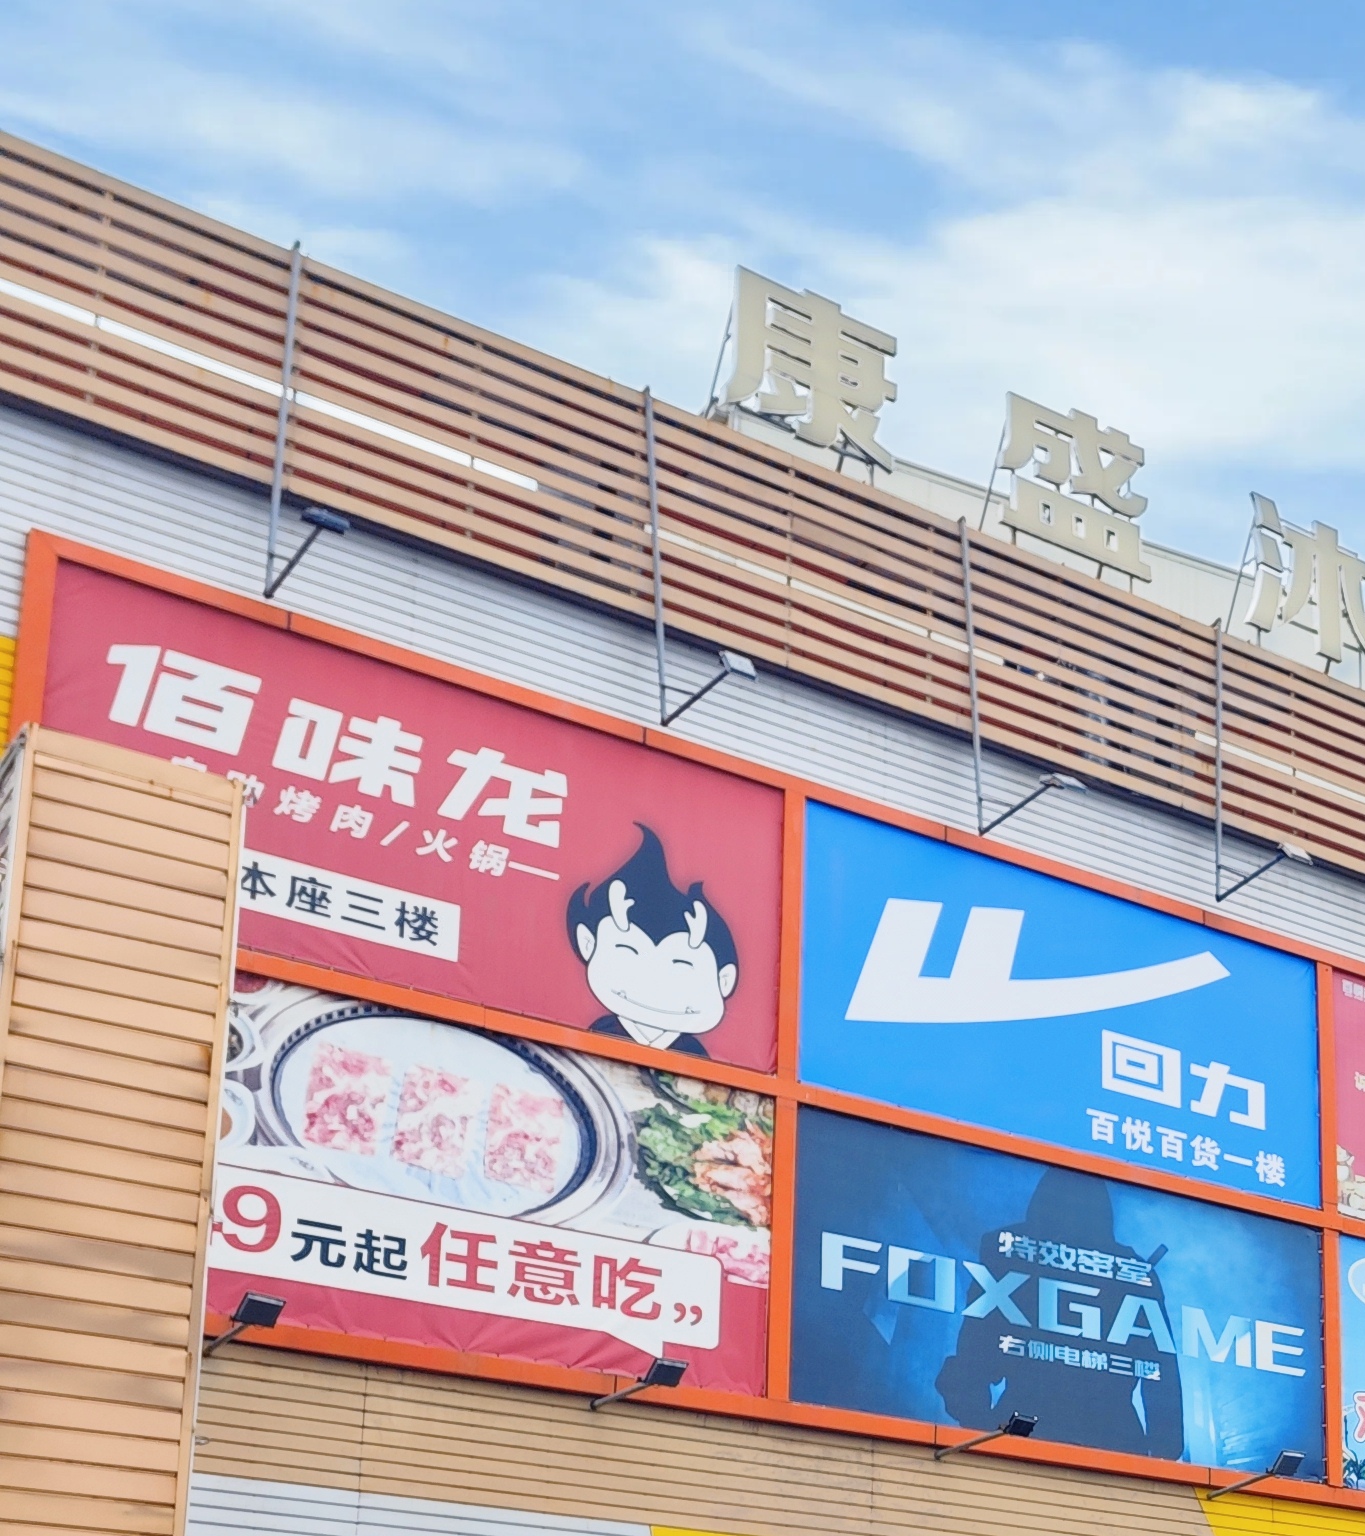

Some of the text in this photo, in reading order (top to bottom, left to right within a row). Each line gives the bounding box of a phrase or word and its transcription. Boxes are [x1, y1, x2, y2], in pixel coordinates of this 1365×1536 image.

[106, 643, 569, 848] 佰味龙
[241, 862, 440, 946] 本座三楼
[1101, 1028, 1267, 1131] 回力
[1086, 1107, 1287, 1188] 百悦百货一楼
[998, 1231, 1154, 1288] 特效密室
[820, 1230, 1307, 1378] FOXGAME
[998, 1334, 1162, 1382] 右侧电梯三楼
